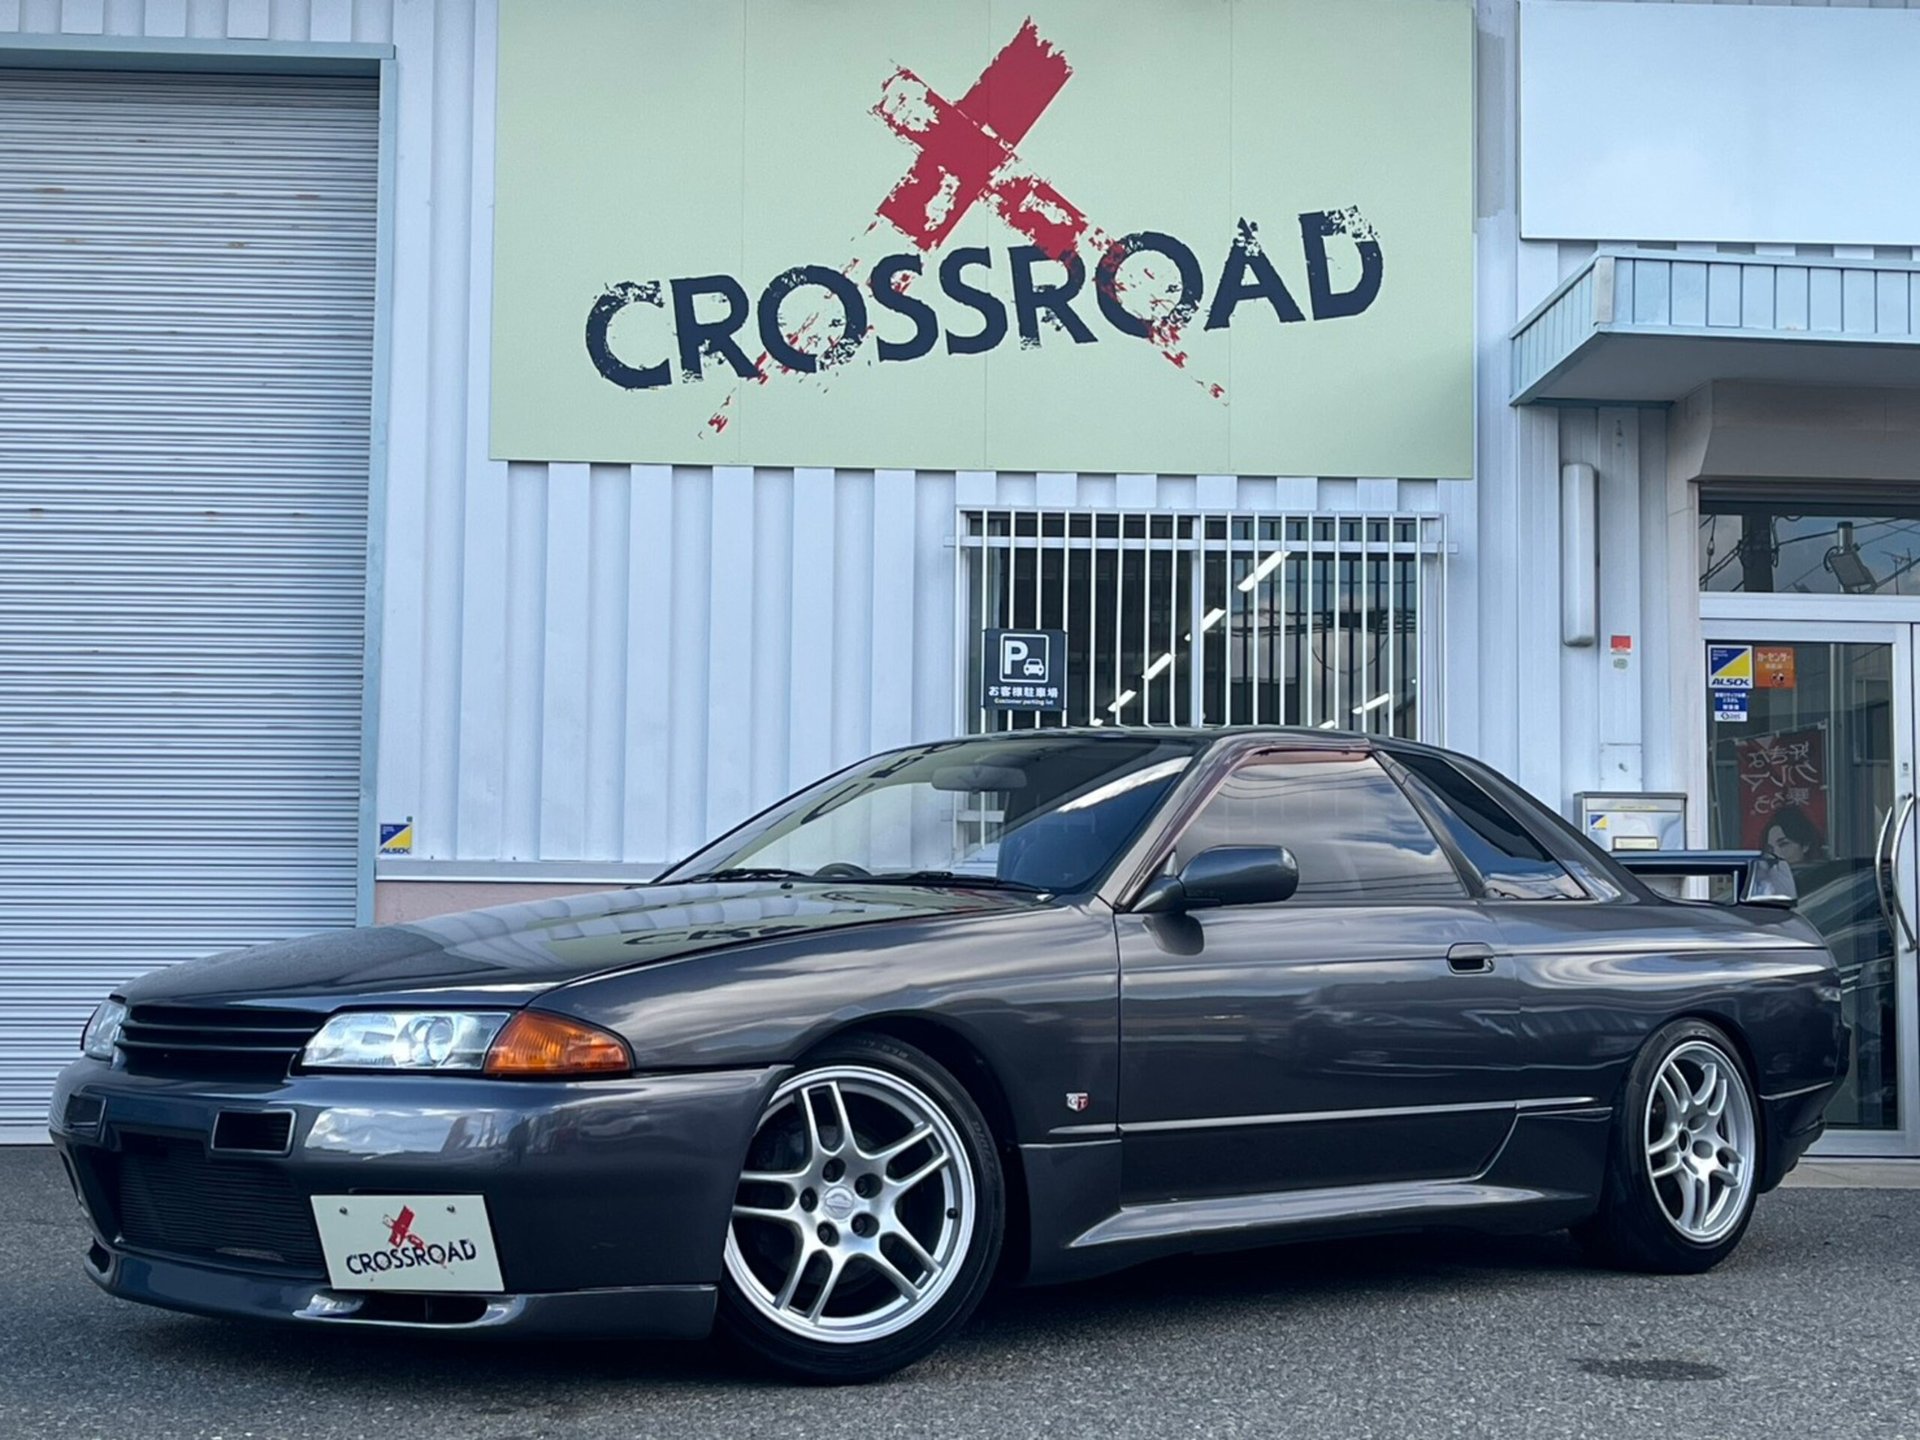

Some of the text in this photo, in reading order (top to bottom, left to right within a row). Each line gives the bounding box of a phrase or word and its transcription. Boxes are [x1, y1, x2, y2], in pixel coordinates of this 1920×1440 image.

[585, 206, 1383, 390] CROSSROAD
[1004, 640, 1028, 674] P
[988, 686, 1058, 698] お客様駐車場
[1711, 678, 1750, 686] ALSOK
[346, 1239, 477, 1275] CROSSROAD
